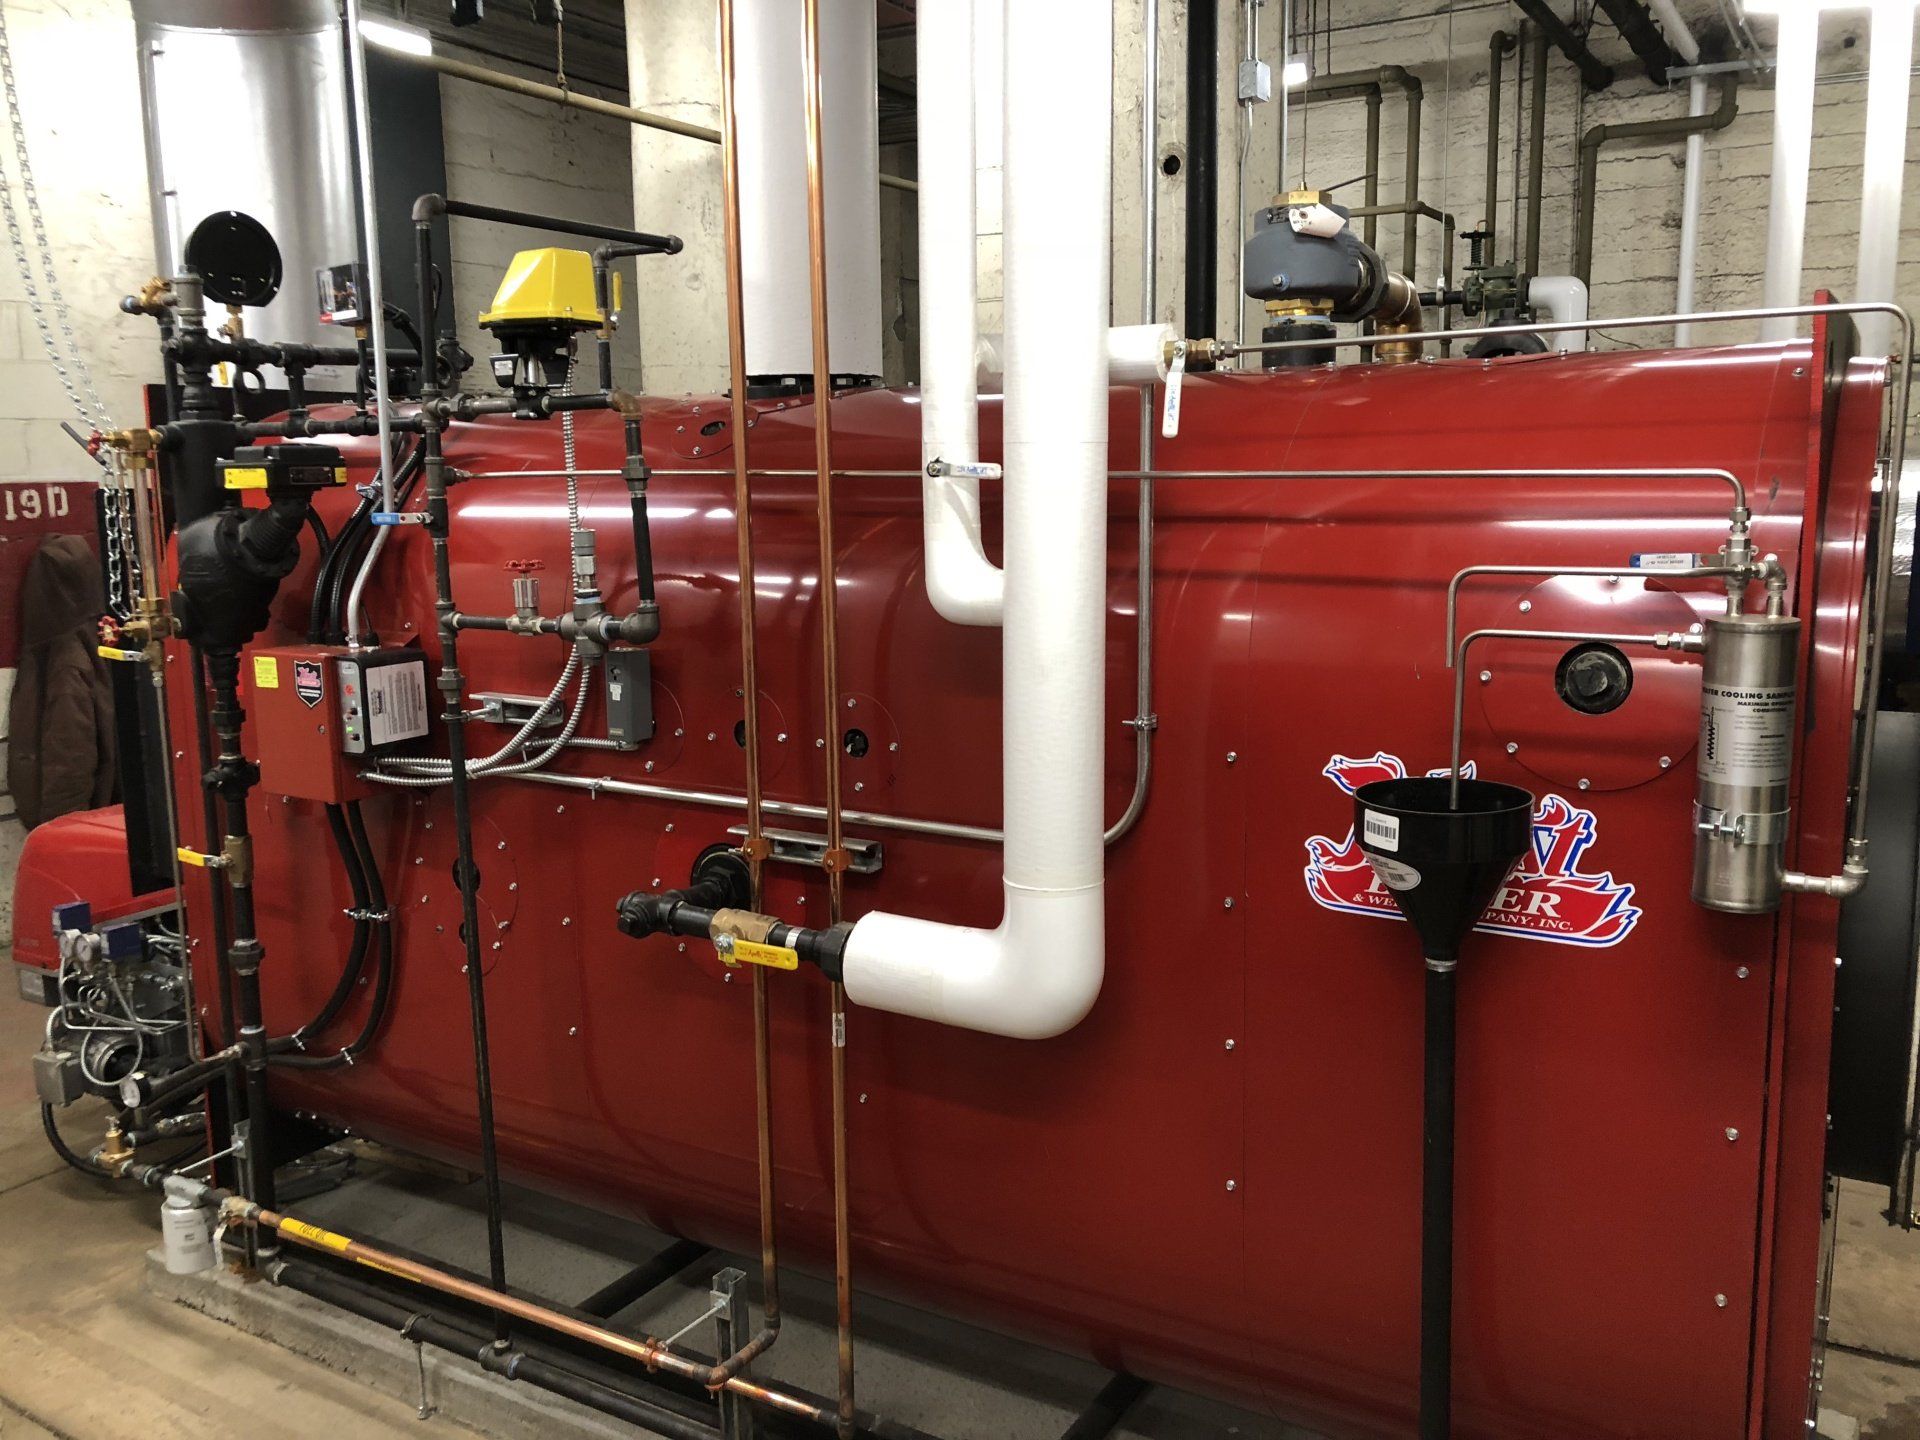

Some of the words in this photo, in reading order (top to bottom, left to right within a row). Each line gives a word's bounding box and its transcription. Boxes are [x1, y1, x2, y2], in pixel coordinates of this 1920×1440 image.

[1721, 690, 1764, 700] COOLING
[1352, 893, 1365, 903] &
[1538, 918, 1574, 931] INC.
